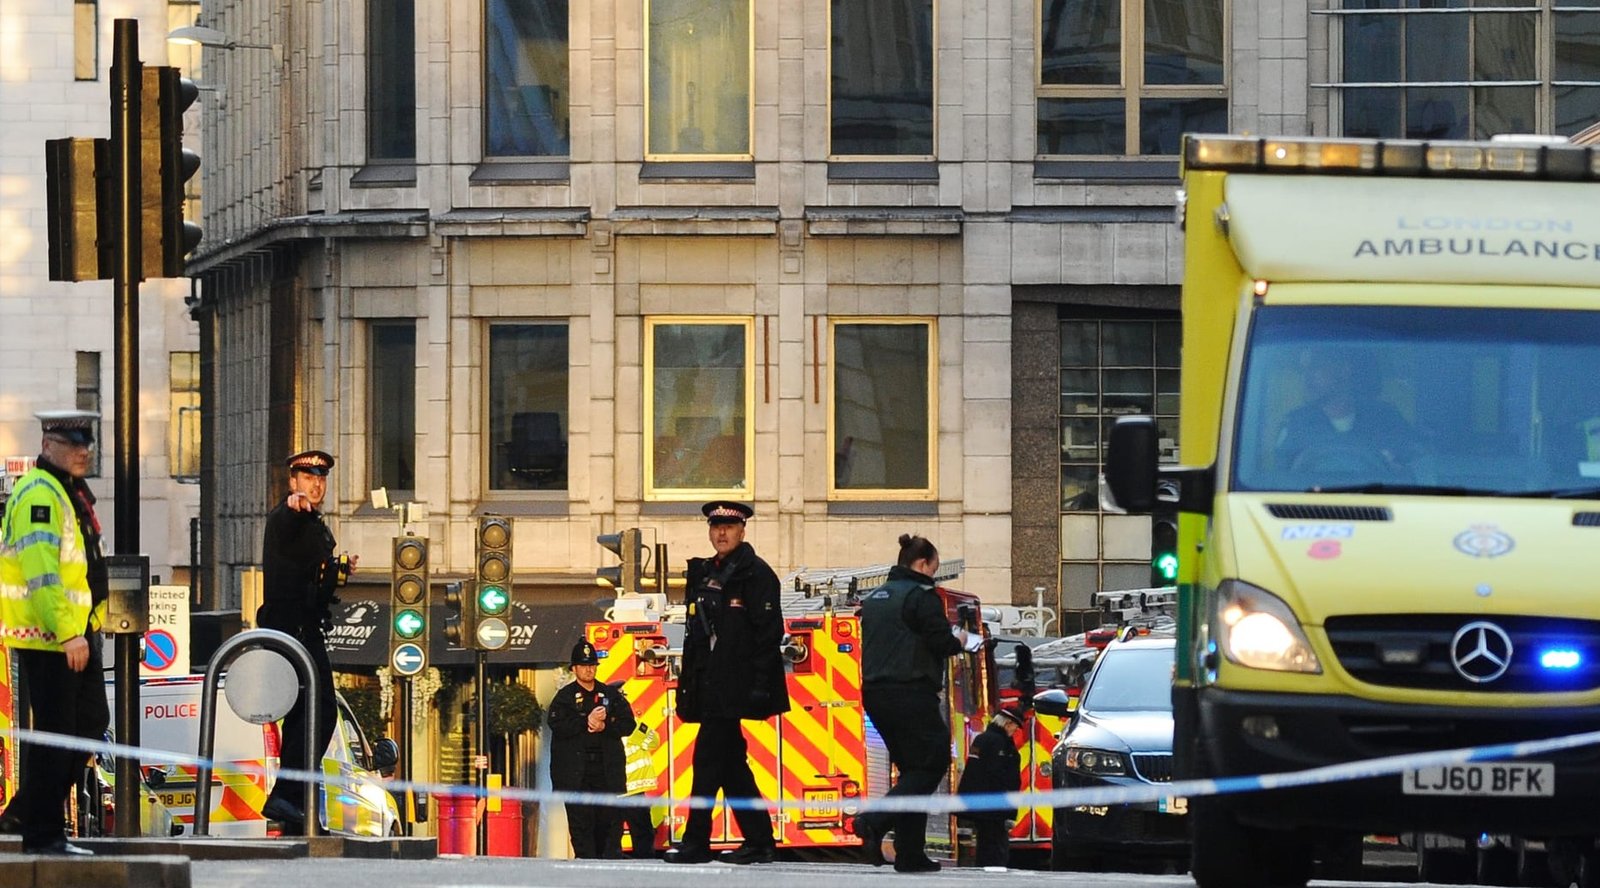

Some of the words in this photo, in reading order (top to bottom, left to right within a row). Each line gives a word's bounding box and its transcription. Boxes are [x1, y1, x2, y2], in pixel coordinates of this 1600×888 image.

[1397, 215, 1573, 233] LONDON
[150, 590, 185, 599] tricted
[151, 602, 177, 611] rking
[149, 614, 177, 624] ONE
[145, 704, 197, 719] POLICE
[1414, 766, 1484, 791] LJ60
[1491, 767, 1542, 792] BFK
